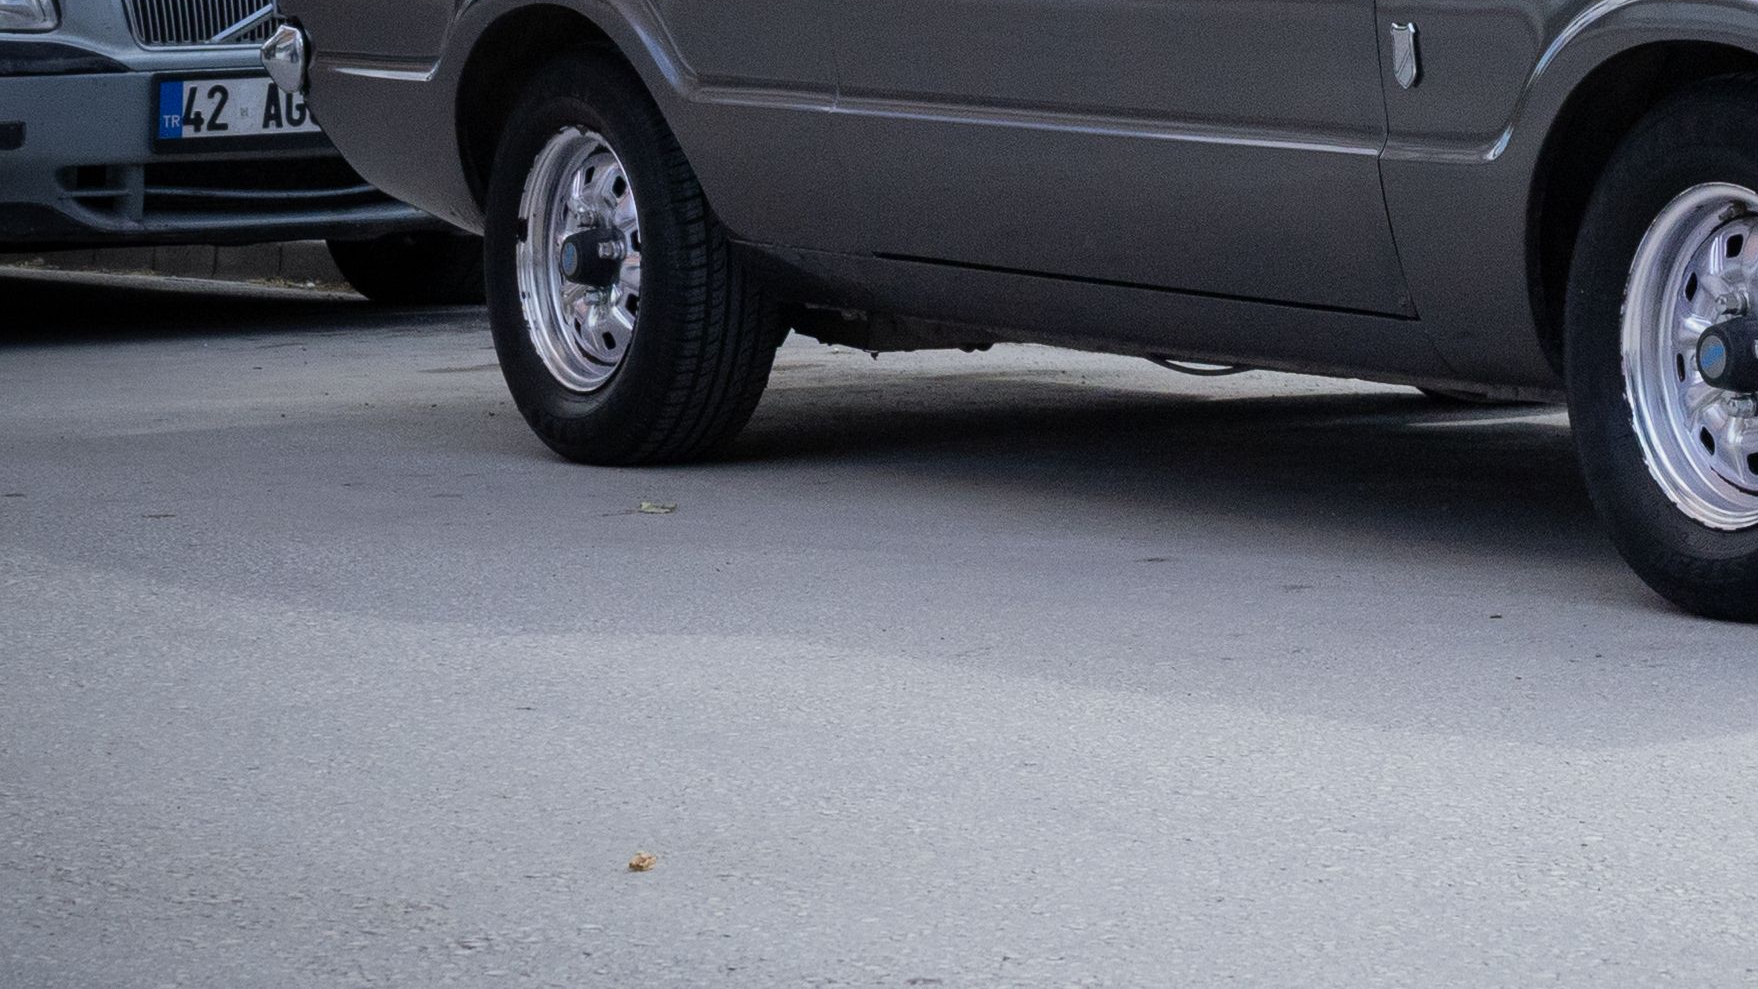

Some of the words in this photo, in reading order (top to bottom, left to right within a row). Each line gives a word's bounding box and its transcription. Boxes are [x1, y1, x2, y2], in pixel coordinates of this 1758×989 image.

[163, 114, 181, 128] TR
[183, 84, 229, 133] 42
[262, 83, 320, 128] AG
